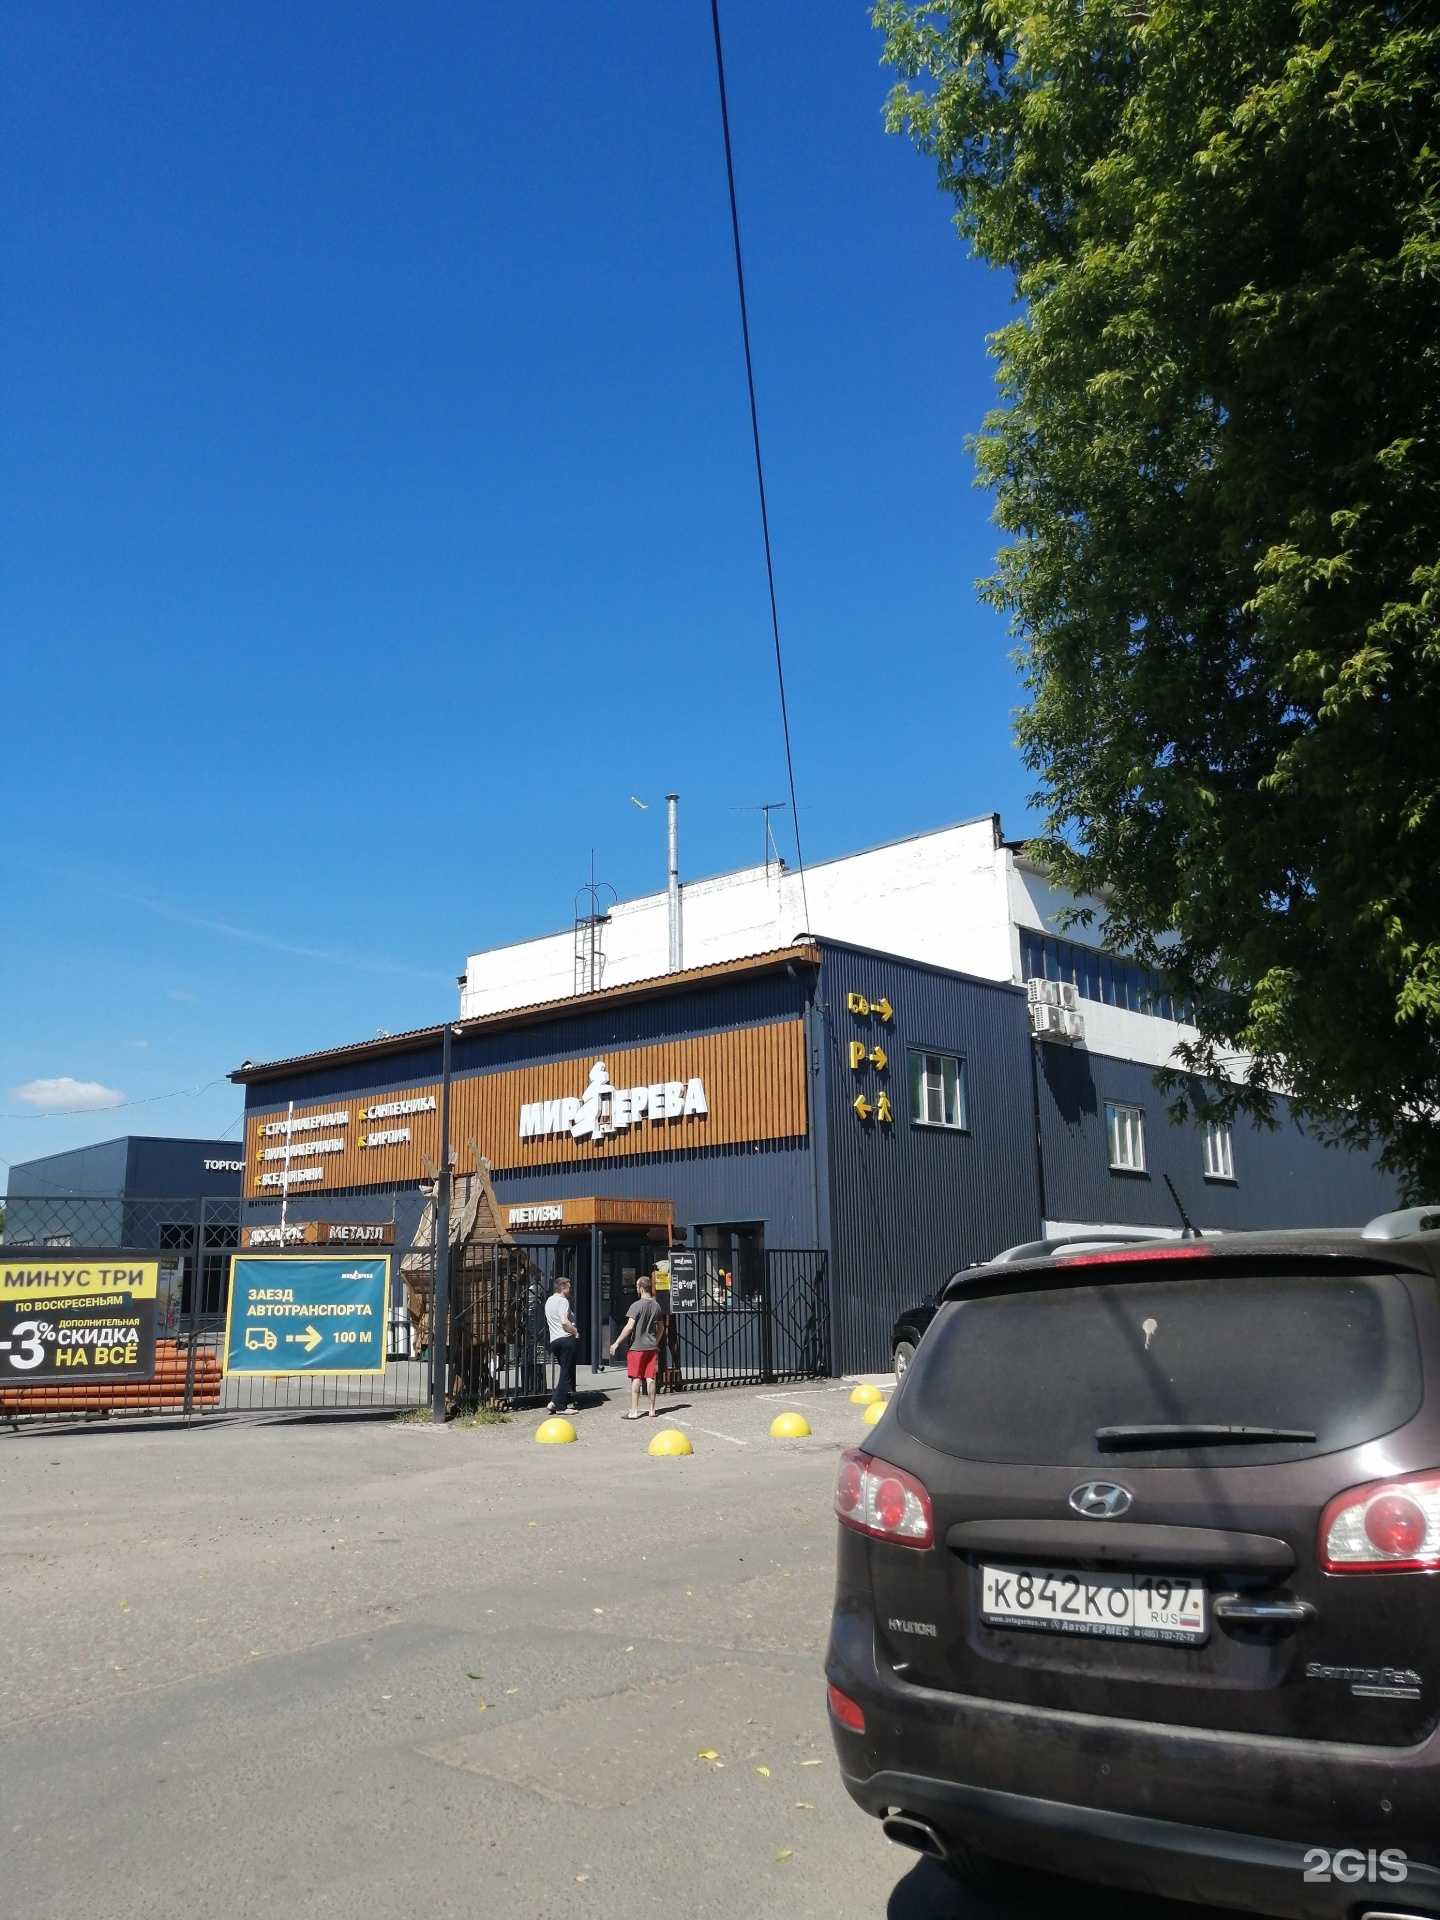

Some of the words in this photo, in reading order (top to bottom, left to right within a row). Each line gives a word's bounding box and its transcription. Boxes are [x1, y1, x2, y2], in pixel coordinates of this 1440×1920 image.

[519, 1096, 581, 1137] МИР
[329, 1225, 385, 1240] МЕТАЛЛ
[4, 1269, 91, 1288] МИНУС
[98, 1269, 144, 1287] ТРИ
[15, 1302, 32, 1312] ПО
[34, 1295, 123, 1312] ВОСКРЕСЕНЬЯМ
[248, 1288, 294, 1303] ЗАЕЗД
[246, 1304, 373, 1317] АВТОТРАНСПОРТА
[58, 1318, 140, 1329] ДОПОЛНИТЕЛЬНАЯ
[57, 1327, 140, 1347] СКИДКА
[333, 1331, 357, 1344] 100
[359, 1331, 372, 1343] М
[55, 1347, 89, 1367] НА
[94, 1342, 138, 1365] ВСЁ
[1139, 1577, 1192, 1612] 197
[1151, 1610, 1179, 1626] RUS
[887, 1617, 937, 1638] HYUNDAI
